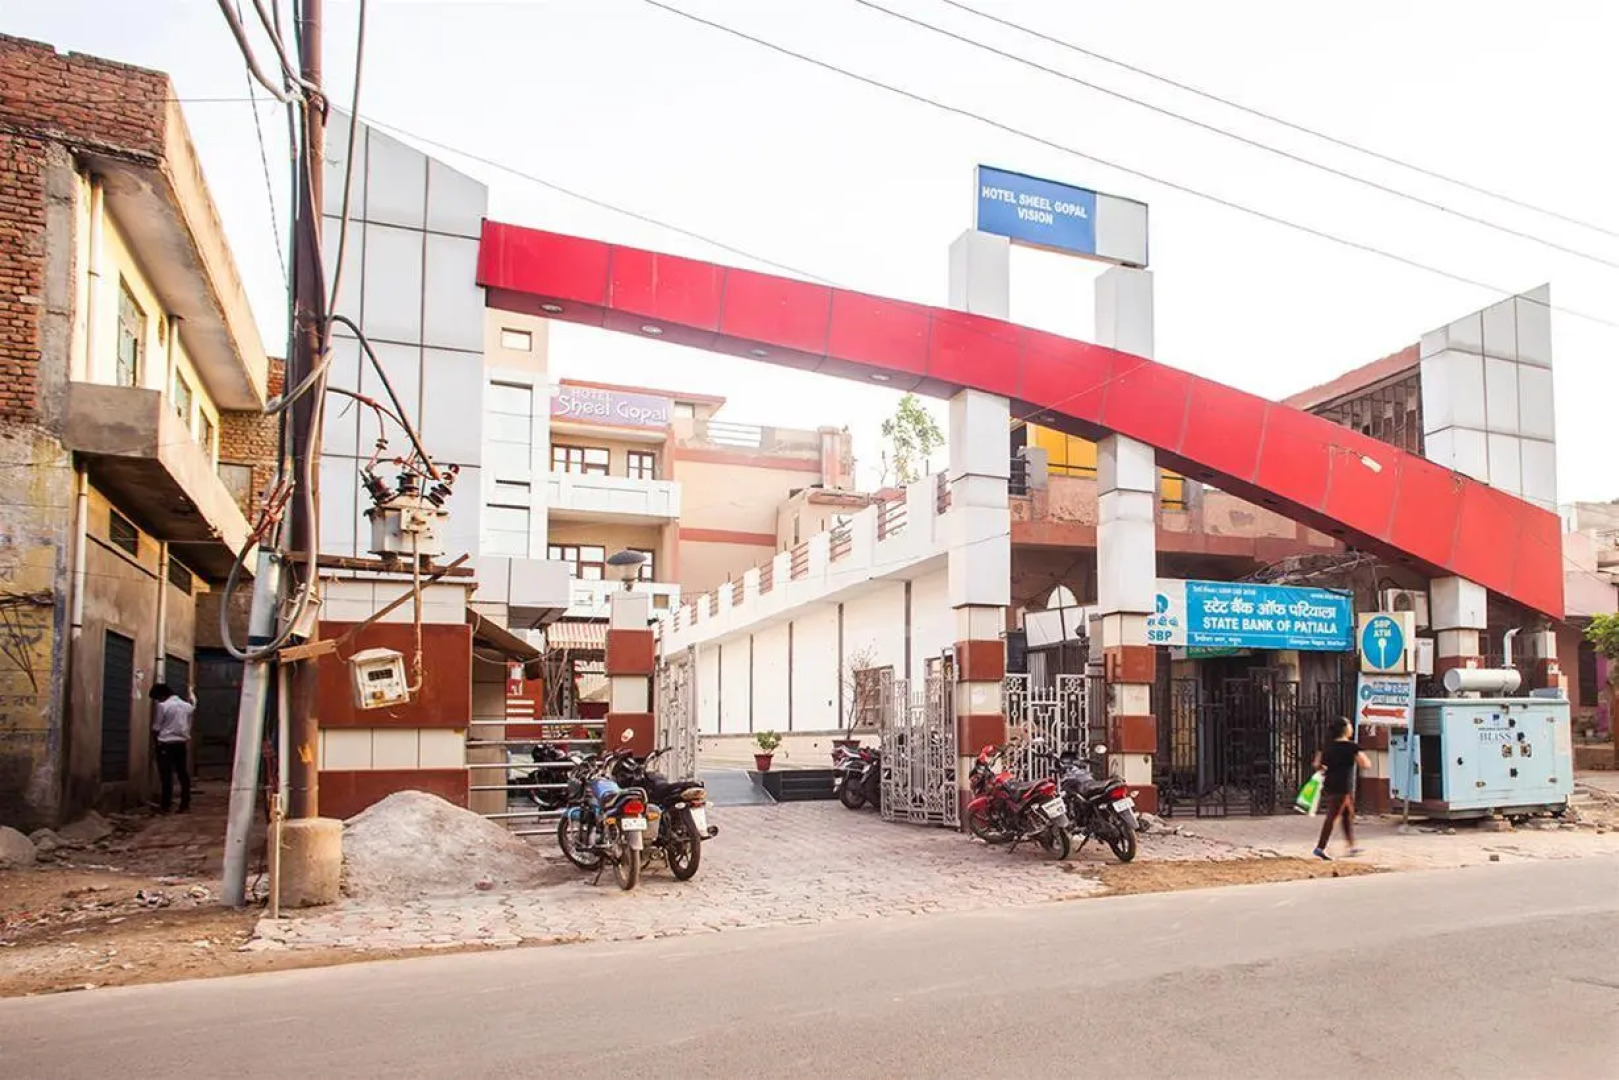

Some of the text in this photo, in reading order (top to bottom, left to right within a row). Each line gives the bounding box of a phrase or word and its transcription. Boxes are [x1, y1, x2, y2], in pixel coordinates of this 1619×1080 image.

[982, 186, 1087, 218] HOTEL SHEEL GOPAL
[1017, 207, 1053, 224] VISION
[555, 393, 668, 424] Sheel Gopal
[1203, 596, 1229, 613] स्टेट
[1230, 596, 1254, 614] बैंक
[1203, 617, 1338, 634] STATE BANK OF PATIALA
[1147, 629, 1173, 641] SBP
